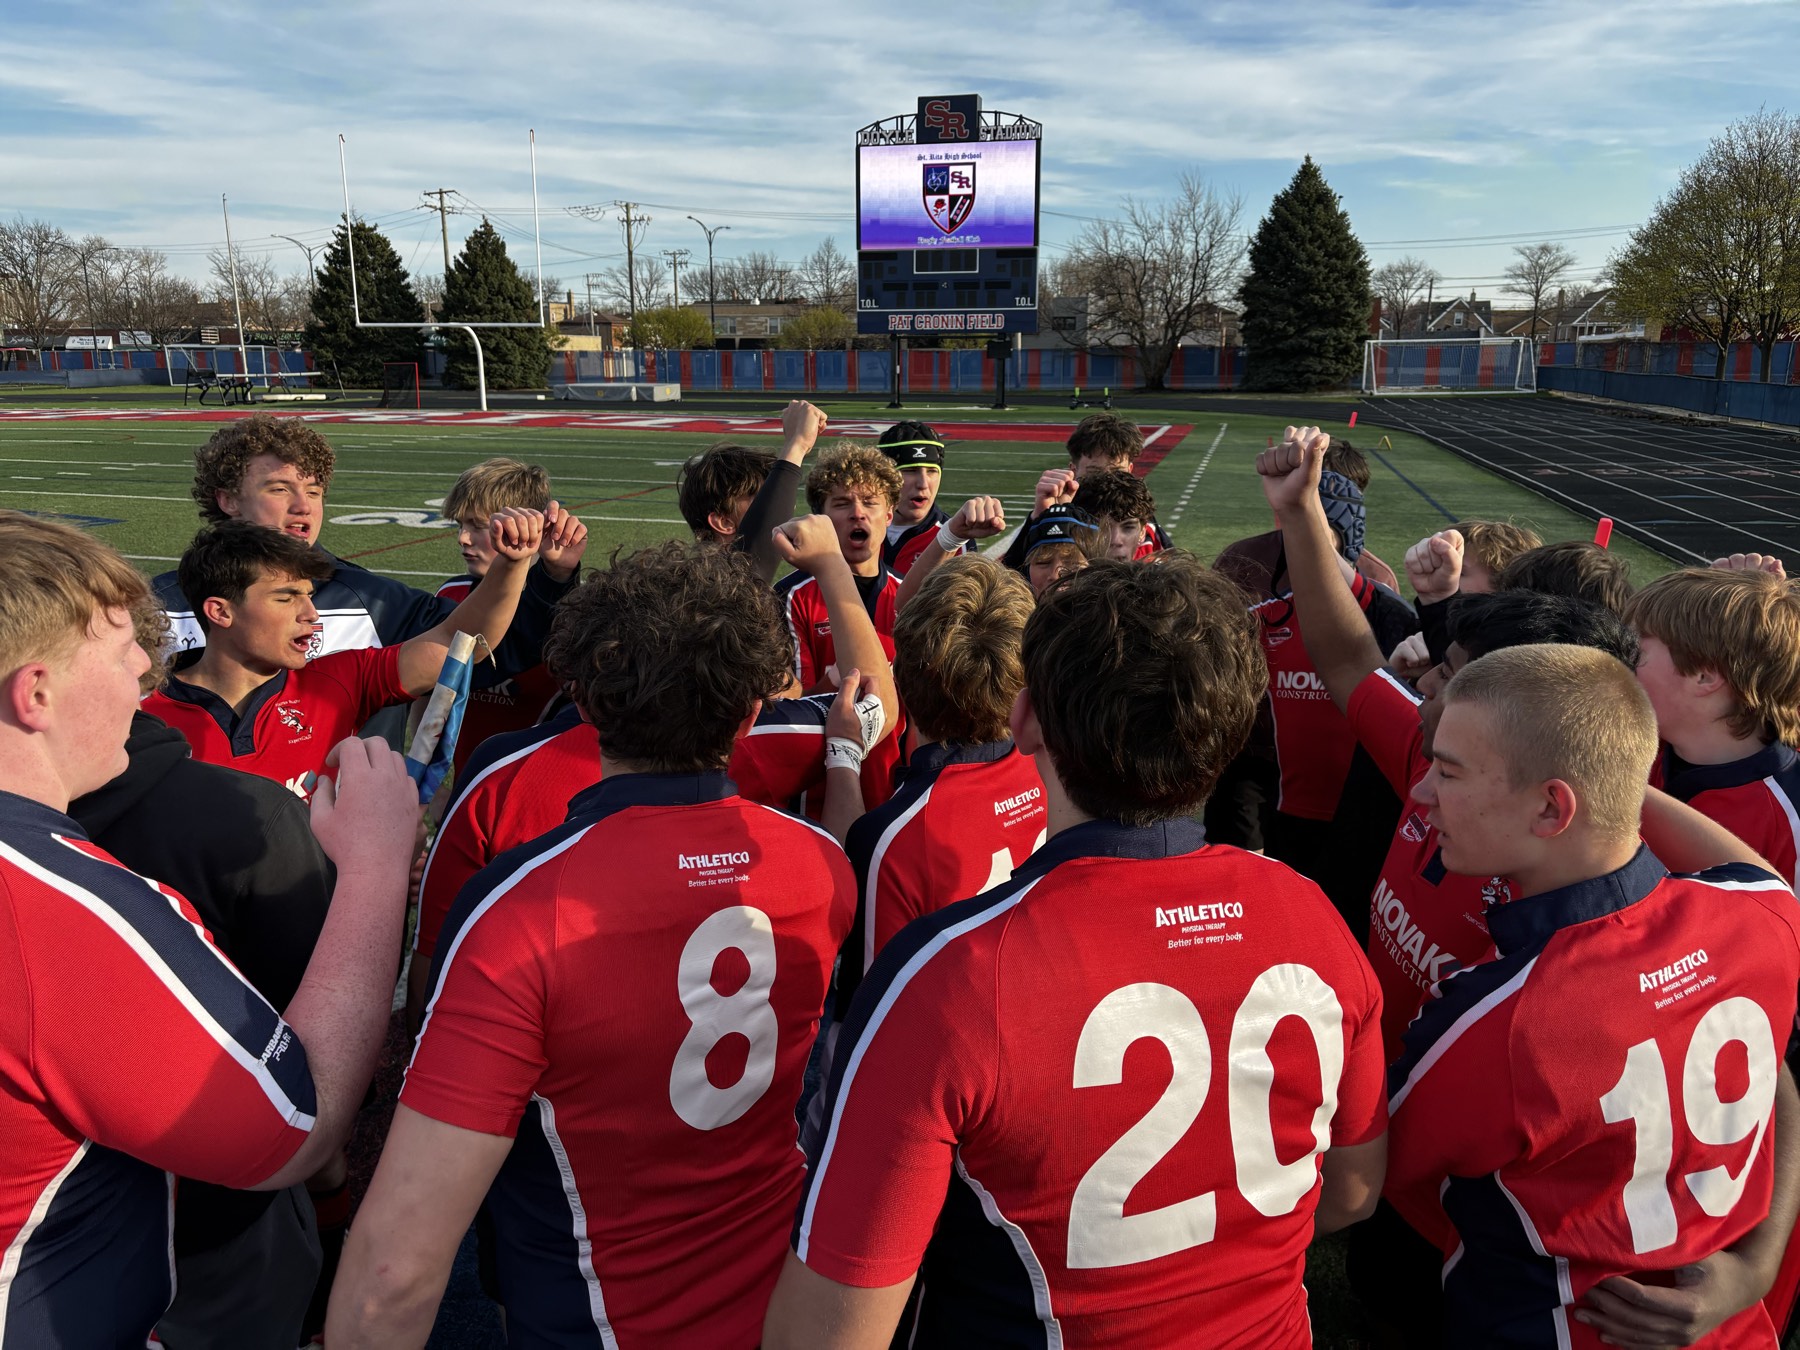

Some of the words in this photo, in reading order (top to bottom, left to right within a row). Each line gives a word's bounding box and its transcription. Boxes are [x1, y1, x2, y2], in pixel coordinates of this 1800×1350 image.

[925, 100, 969, 140] SR
[860, 129, 915, 146] DOYLE
[979, 124, 1040, 141] STADIUM
[944, 152, 960, 161] High
[961, 151, 982, 160] School
[951, 171, 972, 189] SR
[860, 299, 879, 308] T.O.L.
[1015, 296, 1034, 306] T.O.L.
[888, 314, 914, 331] PAT
[914, 314, 965, 330] CRONIN
[966, 313, 1005, 330] FIELD
[993, 787, 1041, 816] ATHLETICO
[678, 851, 750, 869] ATHLETICO
[688, 880, 707, 888] Better
[718, 877, 734, 885] every
[1155, 901, 1244, 928] ATHLETICO
[1181, 924, 1205, 934] PHYSICAL
[1205, 922, 1226, 931] THERAPY
[1372, 877, 1457, 982] NOVAK
[1168, 939, 1192, 949] Better
[1194, 936, 1204, 945] for
[1205, 934, 1225, 945] every
[1225, 932, 1244, 942] body.
[1638, 948, 1709, 993] ATHLETICO
[1654, 996, 1674, 1010] Better
[1673, 991, 1684, 1001] for
[1684, 983, 1701, 997] every
[1699, 974, 1717, 988] body.
[669, 905, 779, 1131] 8
[1066, 962, 1344, 1269] 20
[1599, 996, 1777, 1255] 19
